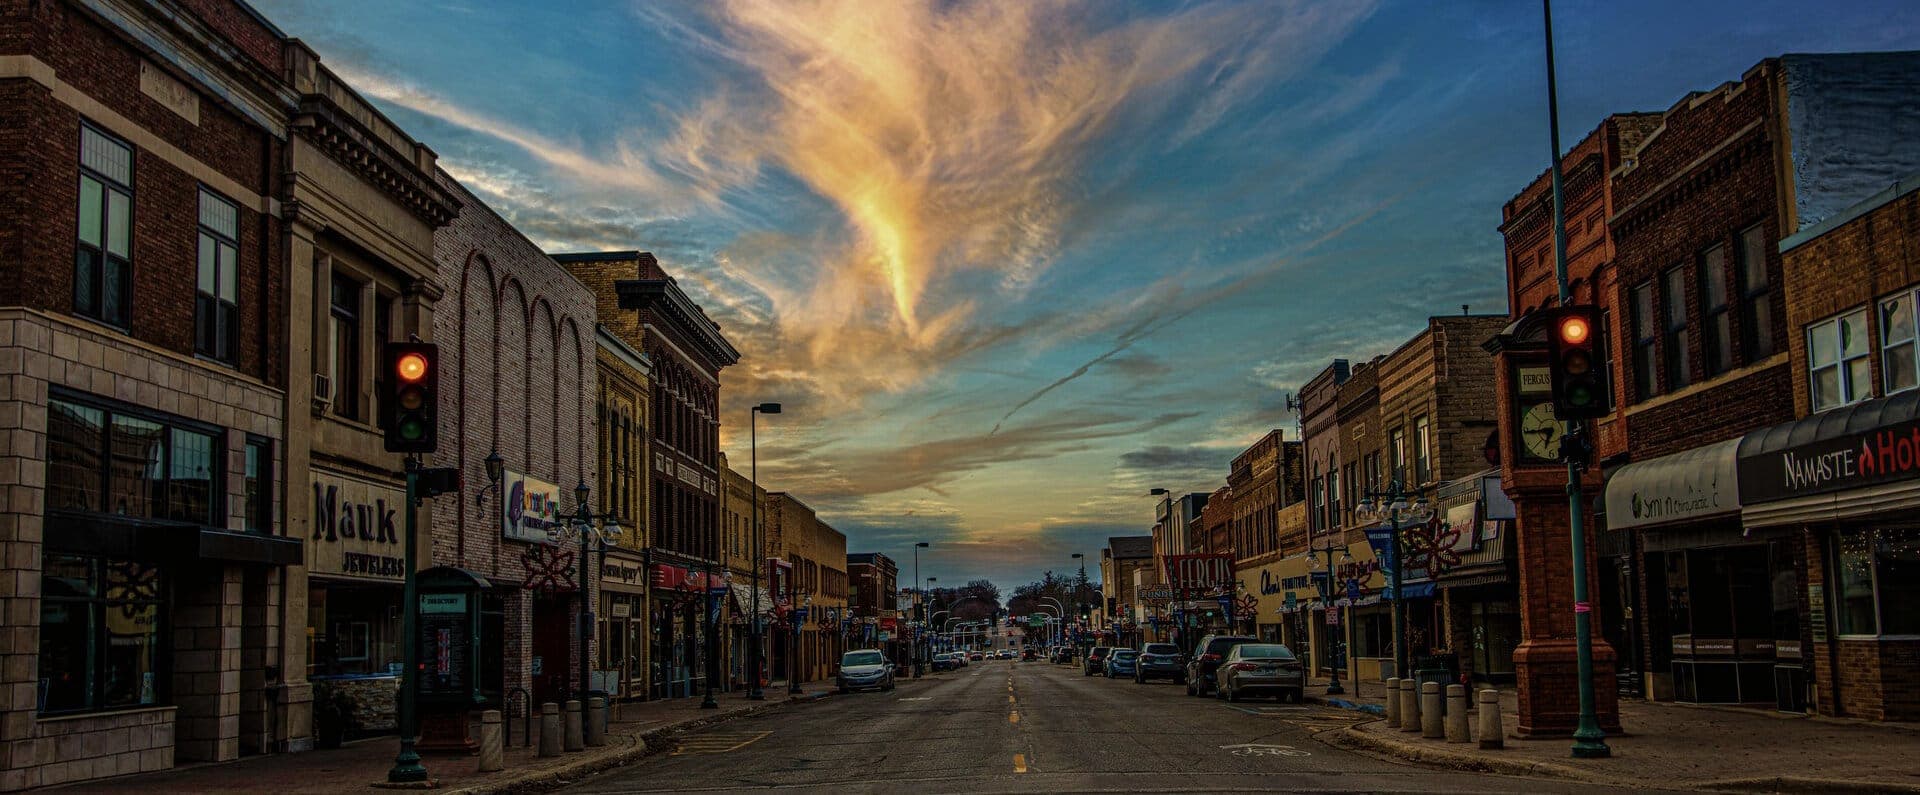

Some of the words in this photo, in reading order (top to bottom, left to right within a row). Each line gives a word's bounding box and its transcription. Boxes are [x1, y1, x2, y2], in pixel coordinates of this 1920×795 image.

[1523, 374, 1551, 385] FERGUS
[1544, 403, 1553, 413] 12
[1548, 449, 1555, 458] 6
[1783, 448, 1856, 490] NAMASTE
[313, 481, 397, 543] Mauk
[343, 551, 404, 577] JEWELERS
[1180, 559, 1232, 588] FERGUS
